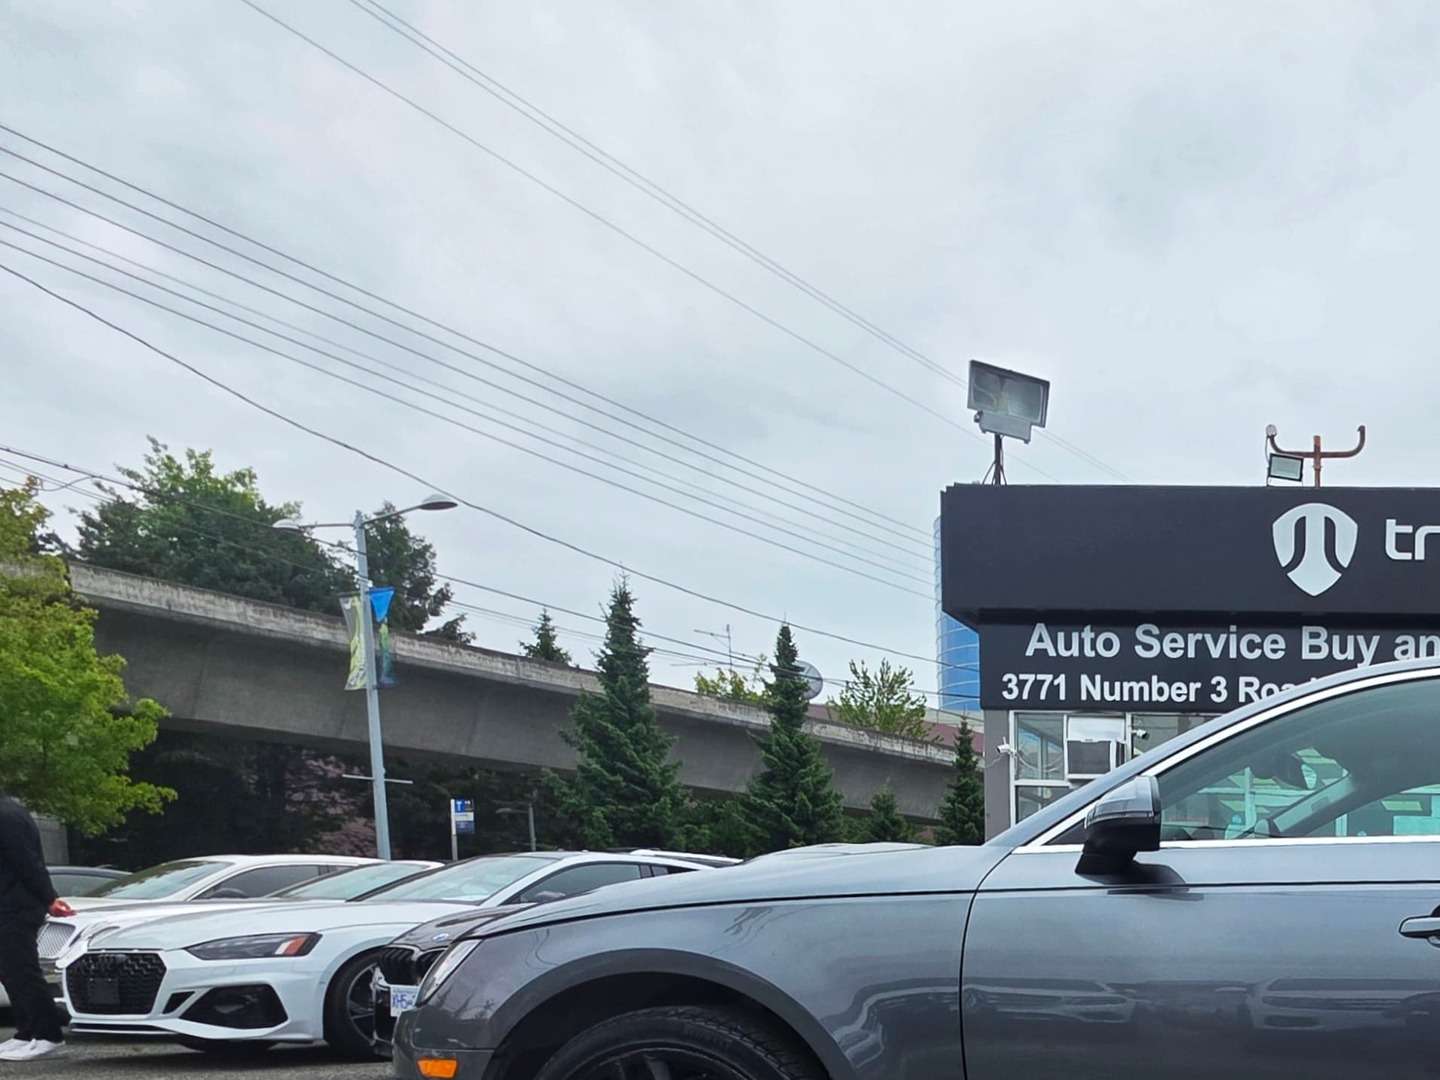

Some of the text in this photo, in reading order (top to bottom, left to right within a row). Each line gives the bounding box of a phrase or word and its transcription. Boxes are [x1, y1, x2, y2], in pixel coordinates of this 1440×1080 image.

[1025, 622, 1121, 658] Auto
[1134, 623, 1287, 660] Service
[1301, 625, 1381, 668] Buy
[1001, 672, 1318, 703] 3771 Number 3 Ro
